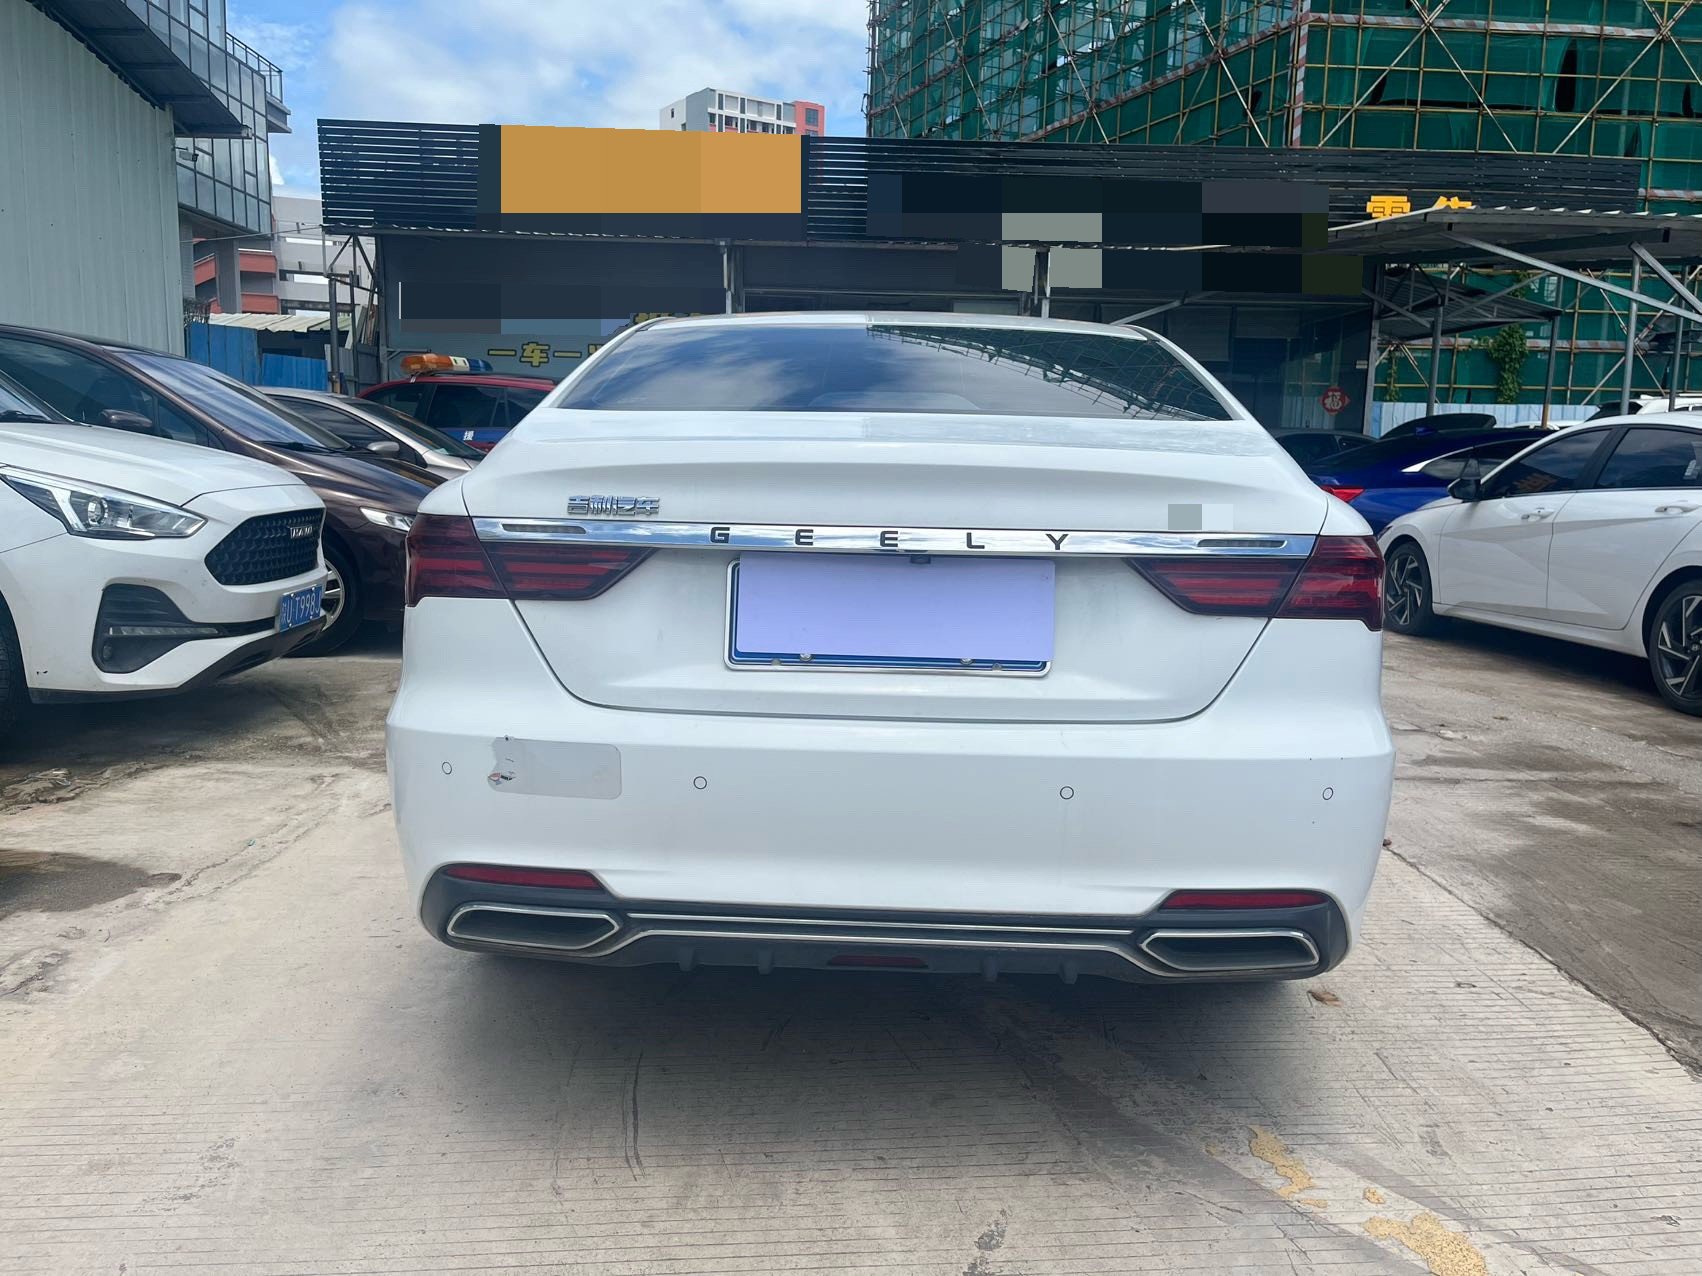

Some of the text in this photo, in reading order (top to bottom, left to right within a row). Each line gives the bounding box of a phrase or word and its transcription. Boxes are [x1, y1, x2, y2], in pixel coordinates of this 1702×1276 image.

[488, 341, 604, 367] 一车一
[567, 495, 660, 516] 吉利汽车
[709, 526, 1069, 551] GEELY
